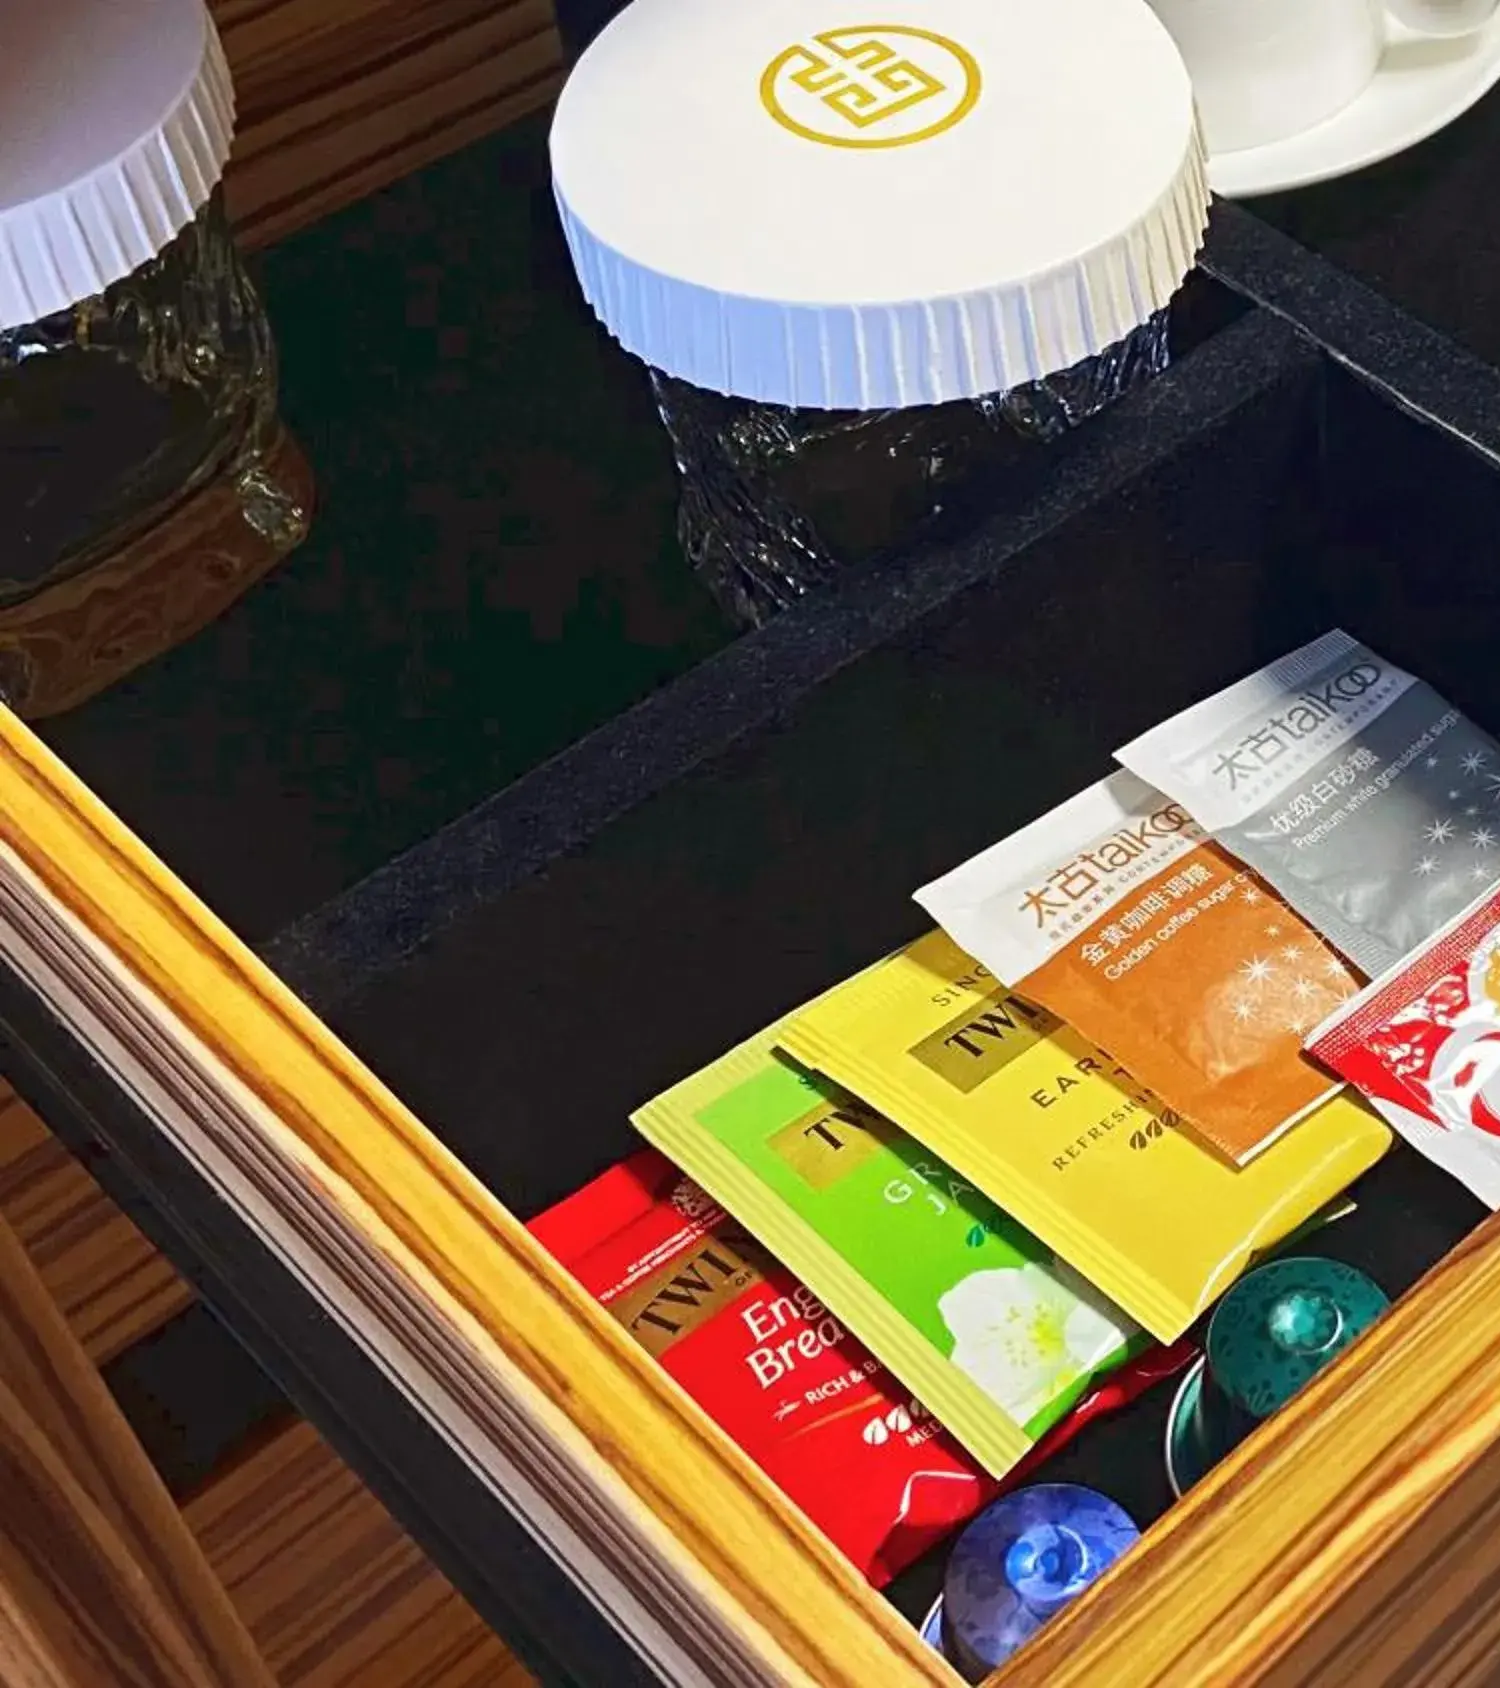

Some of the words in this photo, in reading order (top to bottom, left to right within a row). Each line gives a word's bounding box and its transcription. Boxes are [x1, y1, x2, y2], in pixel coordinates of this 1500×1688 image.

[1292, 810, 1346, 849] Premium
[1104, 937, 1159, 981] Golden
[1156, 905, 1199, 943] coffee
[1197, 880, 1236, 910] sugar
[883, 1161, 943, 1204] GR
[740, 1286, 825, 1345] Eng
[745, 1317, 845, 1390] Brea
[804, 1376, 849, 1405] RICH
[848, 1369, 866, 1384] &
